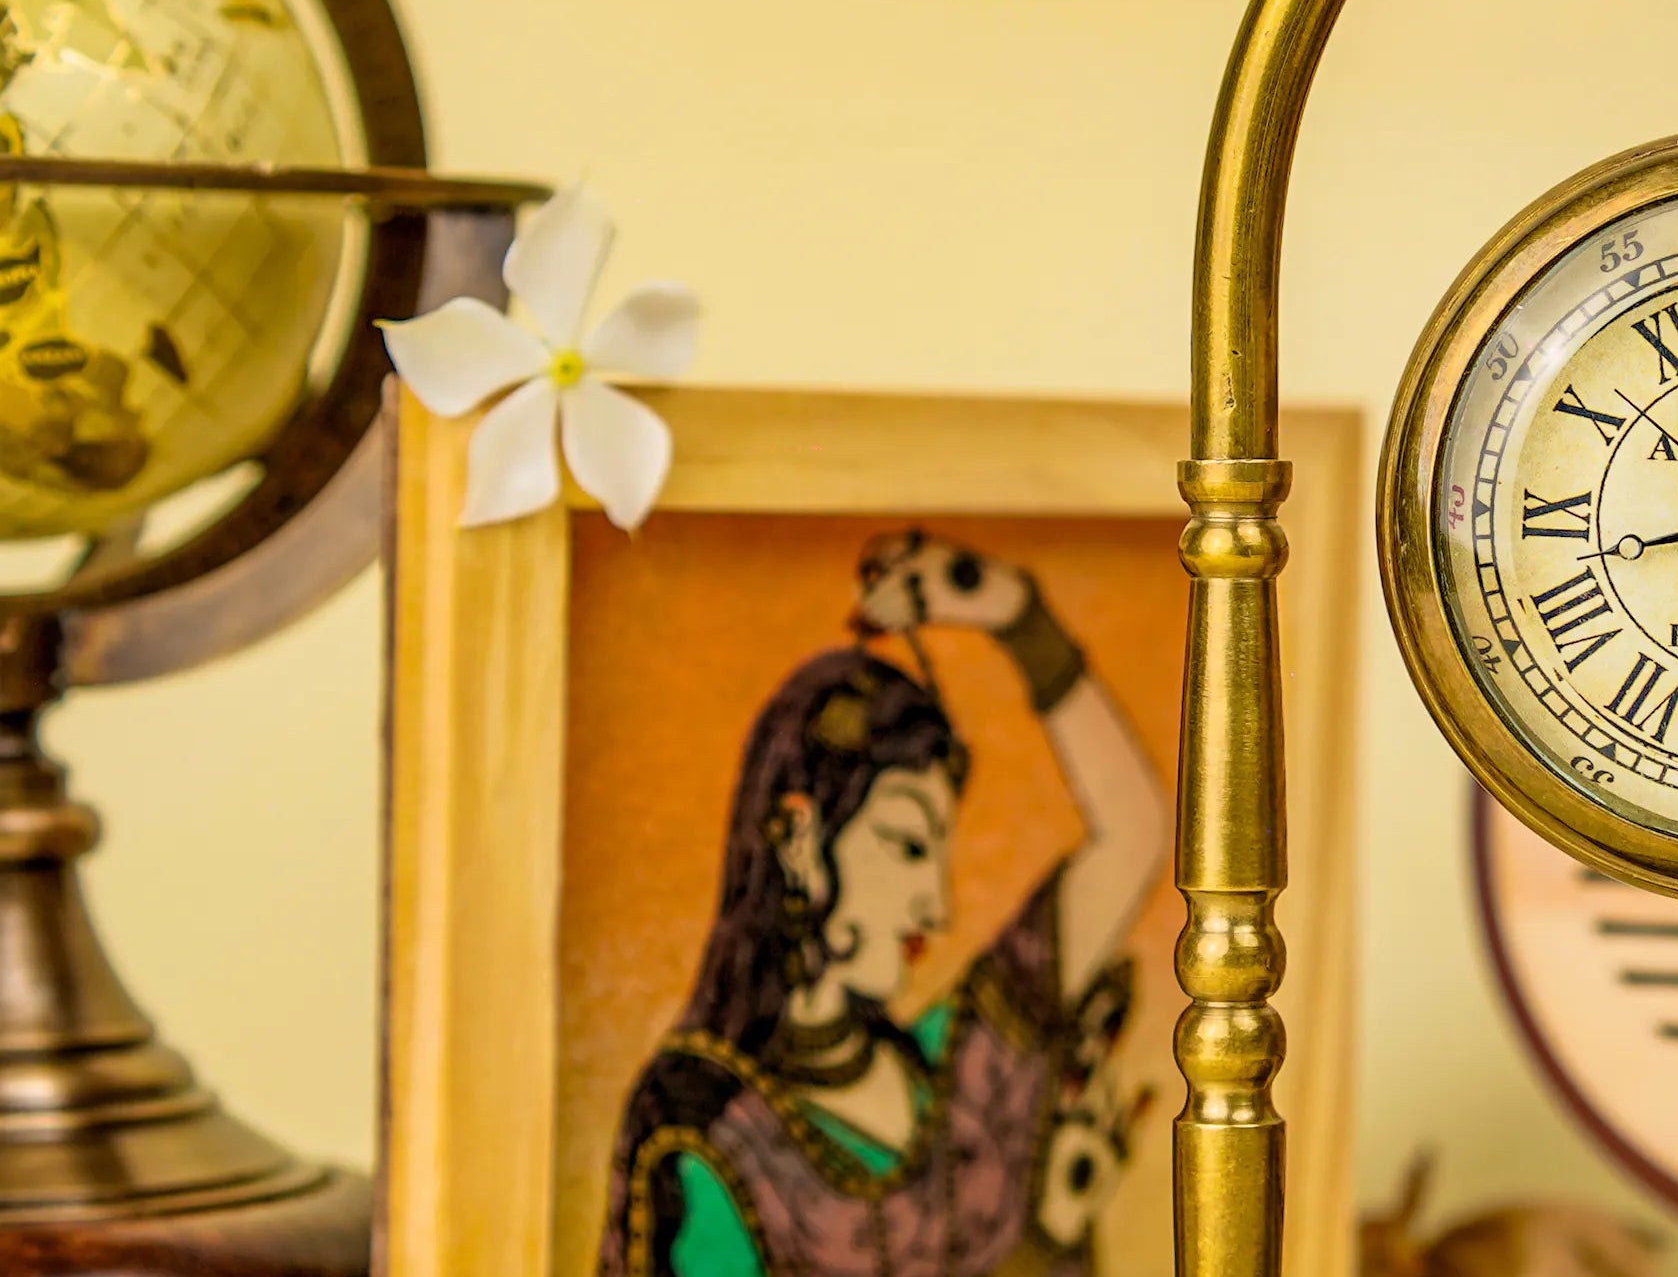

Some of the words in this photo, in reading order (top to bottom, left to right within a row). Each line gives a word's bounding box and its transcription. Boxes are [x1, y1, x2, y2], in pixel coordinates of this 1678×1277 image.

[1599, 229, 1646, 274] 55
[1484, 332, 1521, 382] 50
[1553, 383, 1627, 447] X
[1522, 488, 1593, 543] IX
[1530, 565, 1624, 674] VIII
